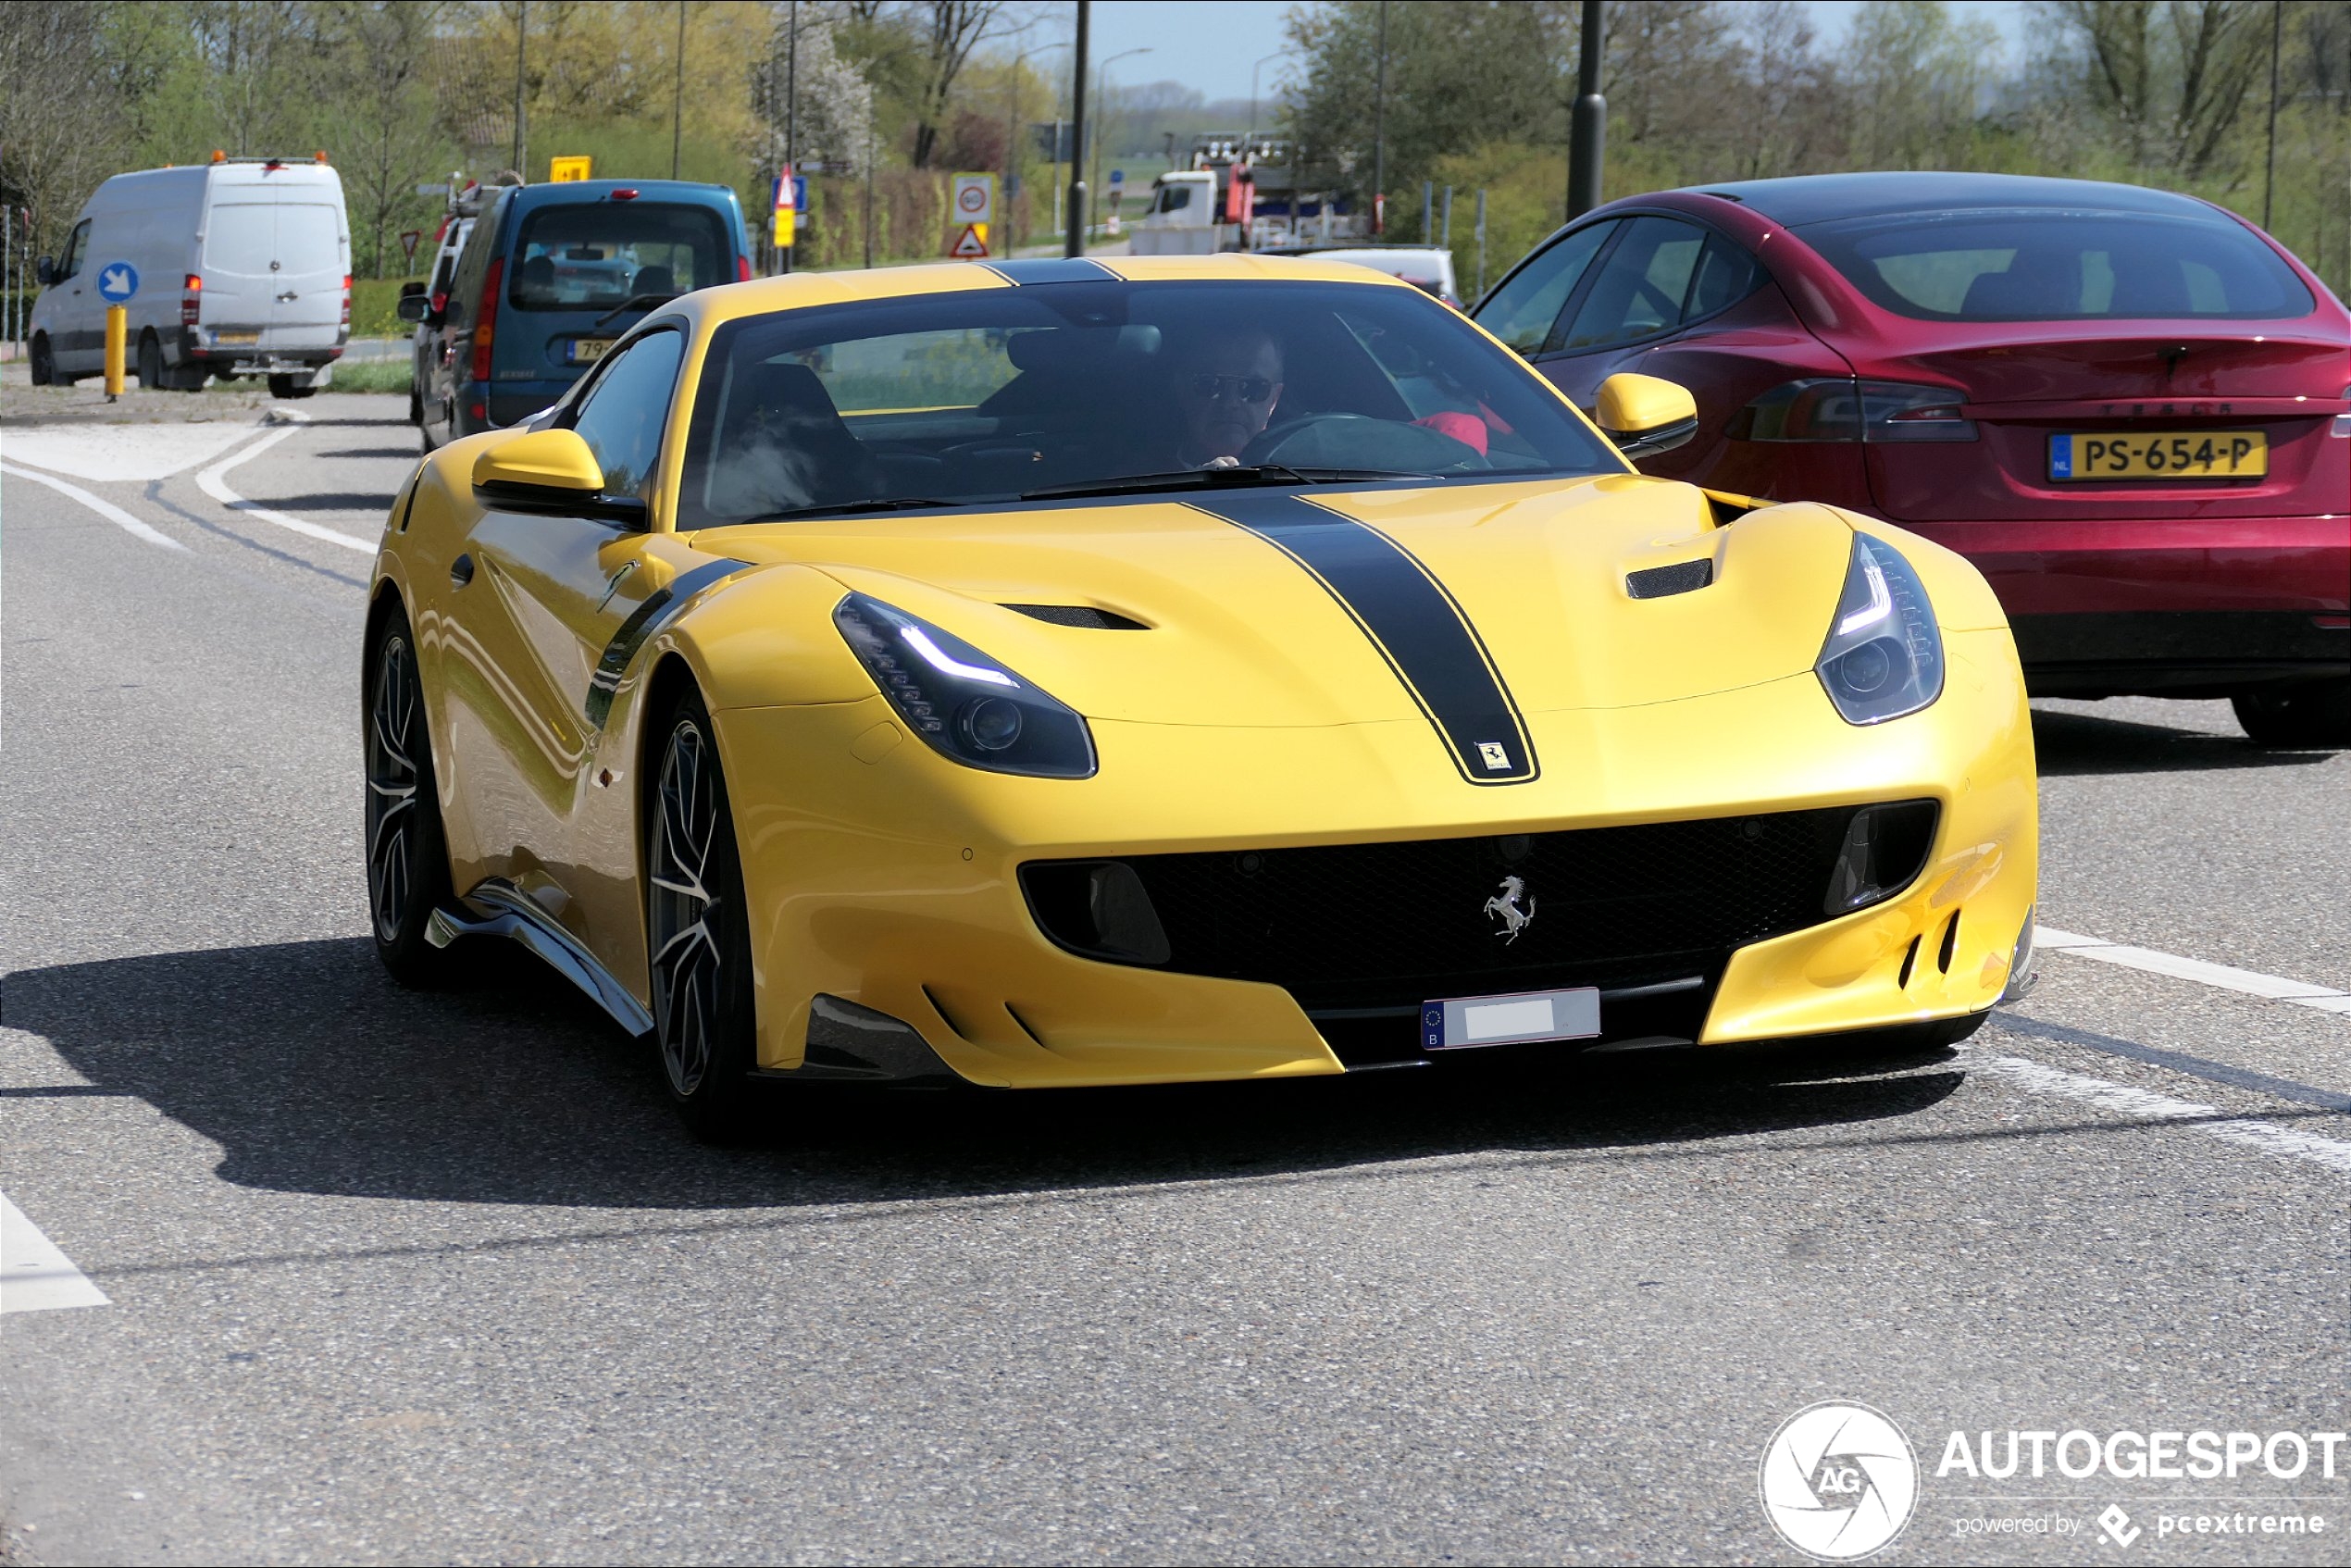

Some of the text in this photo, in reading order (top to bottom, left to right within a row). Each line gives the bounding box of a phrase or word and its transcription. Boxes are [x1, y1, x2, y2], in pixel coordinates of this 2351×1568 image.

[582, 342, 612, 357] 79-
[2101, 404, 2232, 416] TESLA
[2085, 438, 2252, 473] PS-654-P
[2054, 460, 2069, 471] NL
[1429, 1034, 1437, 1044] B
